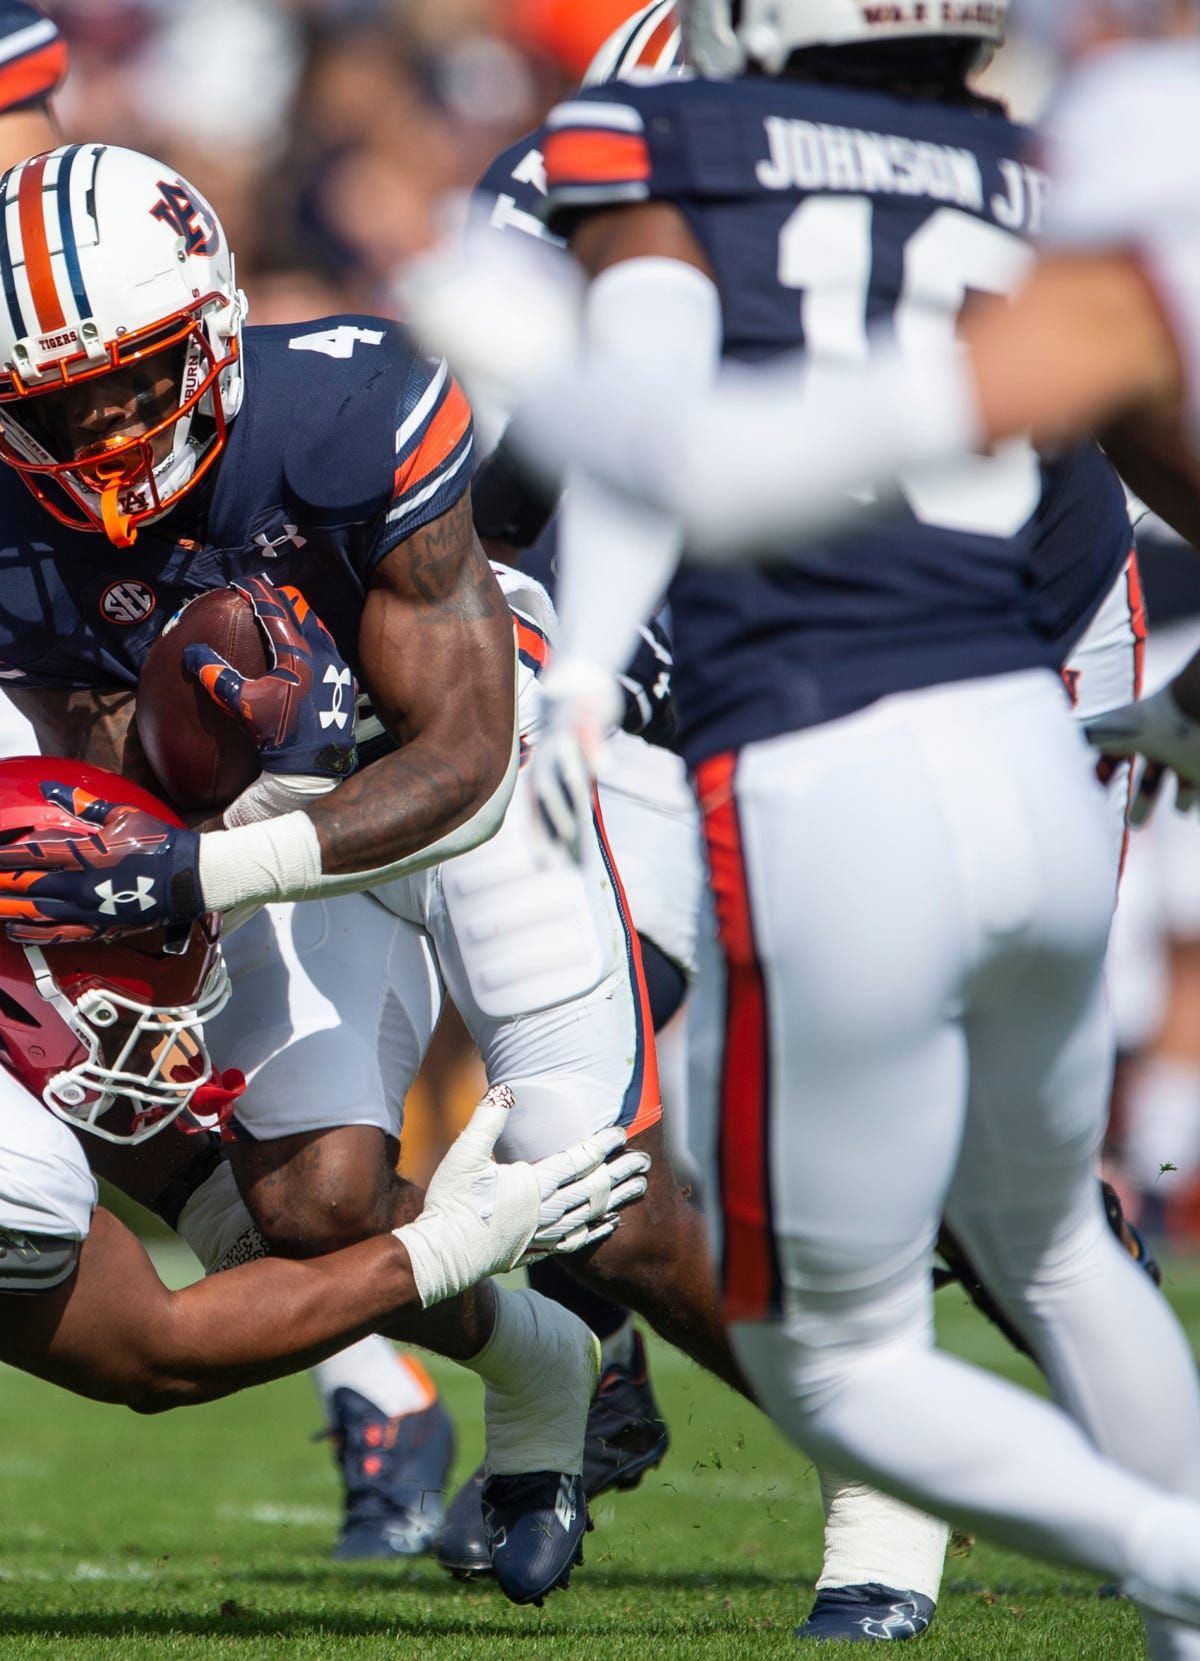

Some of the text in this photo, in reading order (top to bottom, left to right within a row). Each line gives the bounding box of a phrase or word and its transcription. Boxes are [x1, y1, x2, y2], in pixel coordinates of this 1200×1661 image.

[755, 115, 984, 212] JOHNSON
[38, 331, 78, 351] TIGERS
[287, 325, 386, 359] 4
[103, 581, 152, 622] SEC
